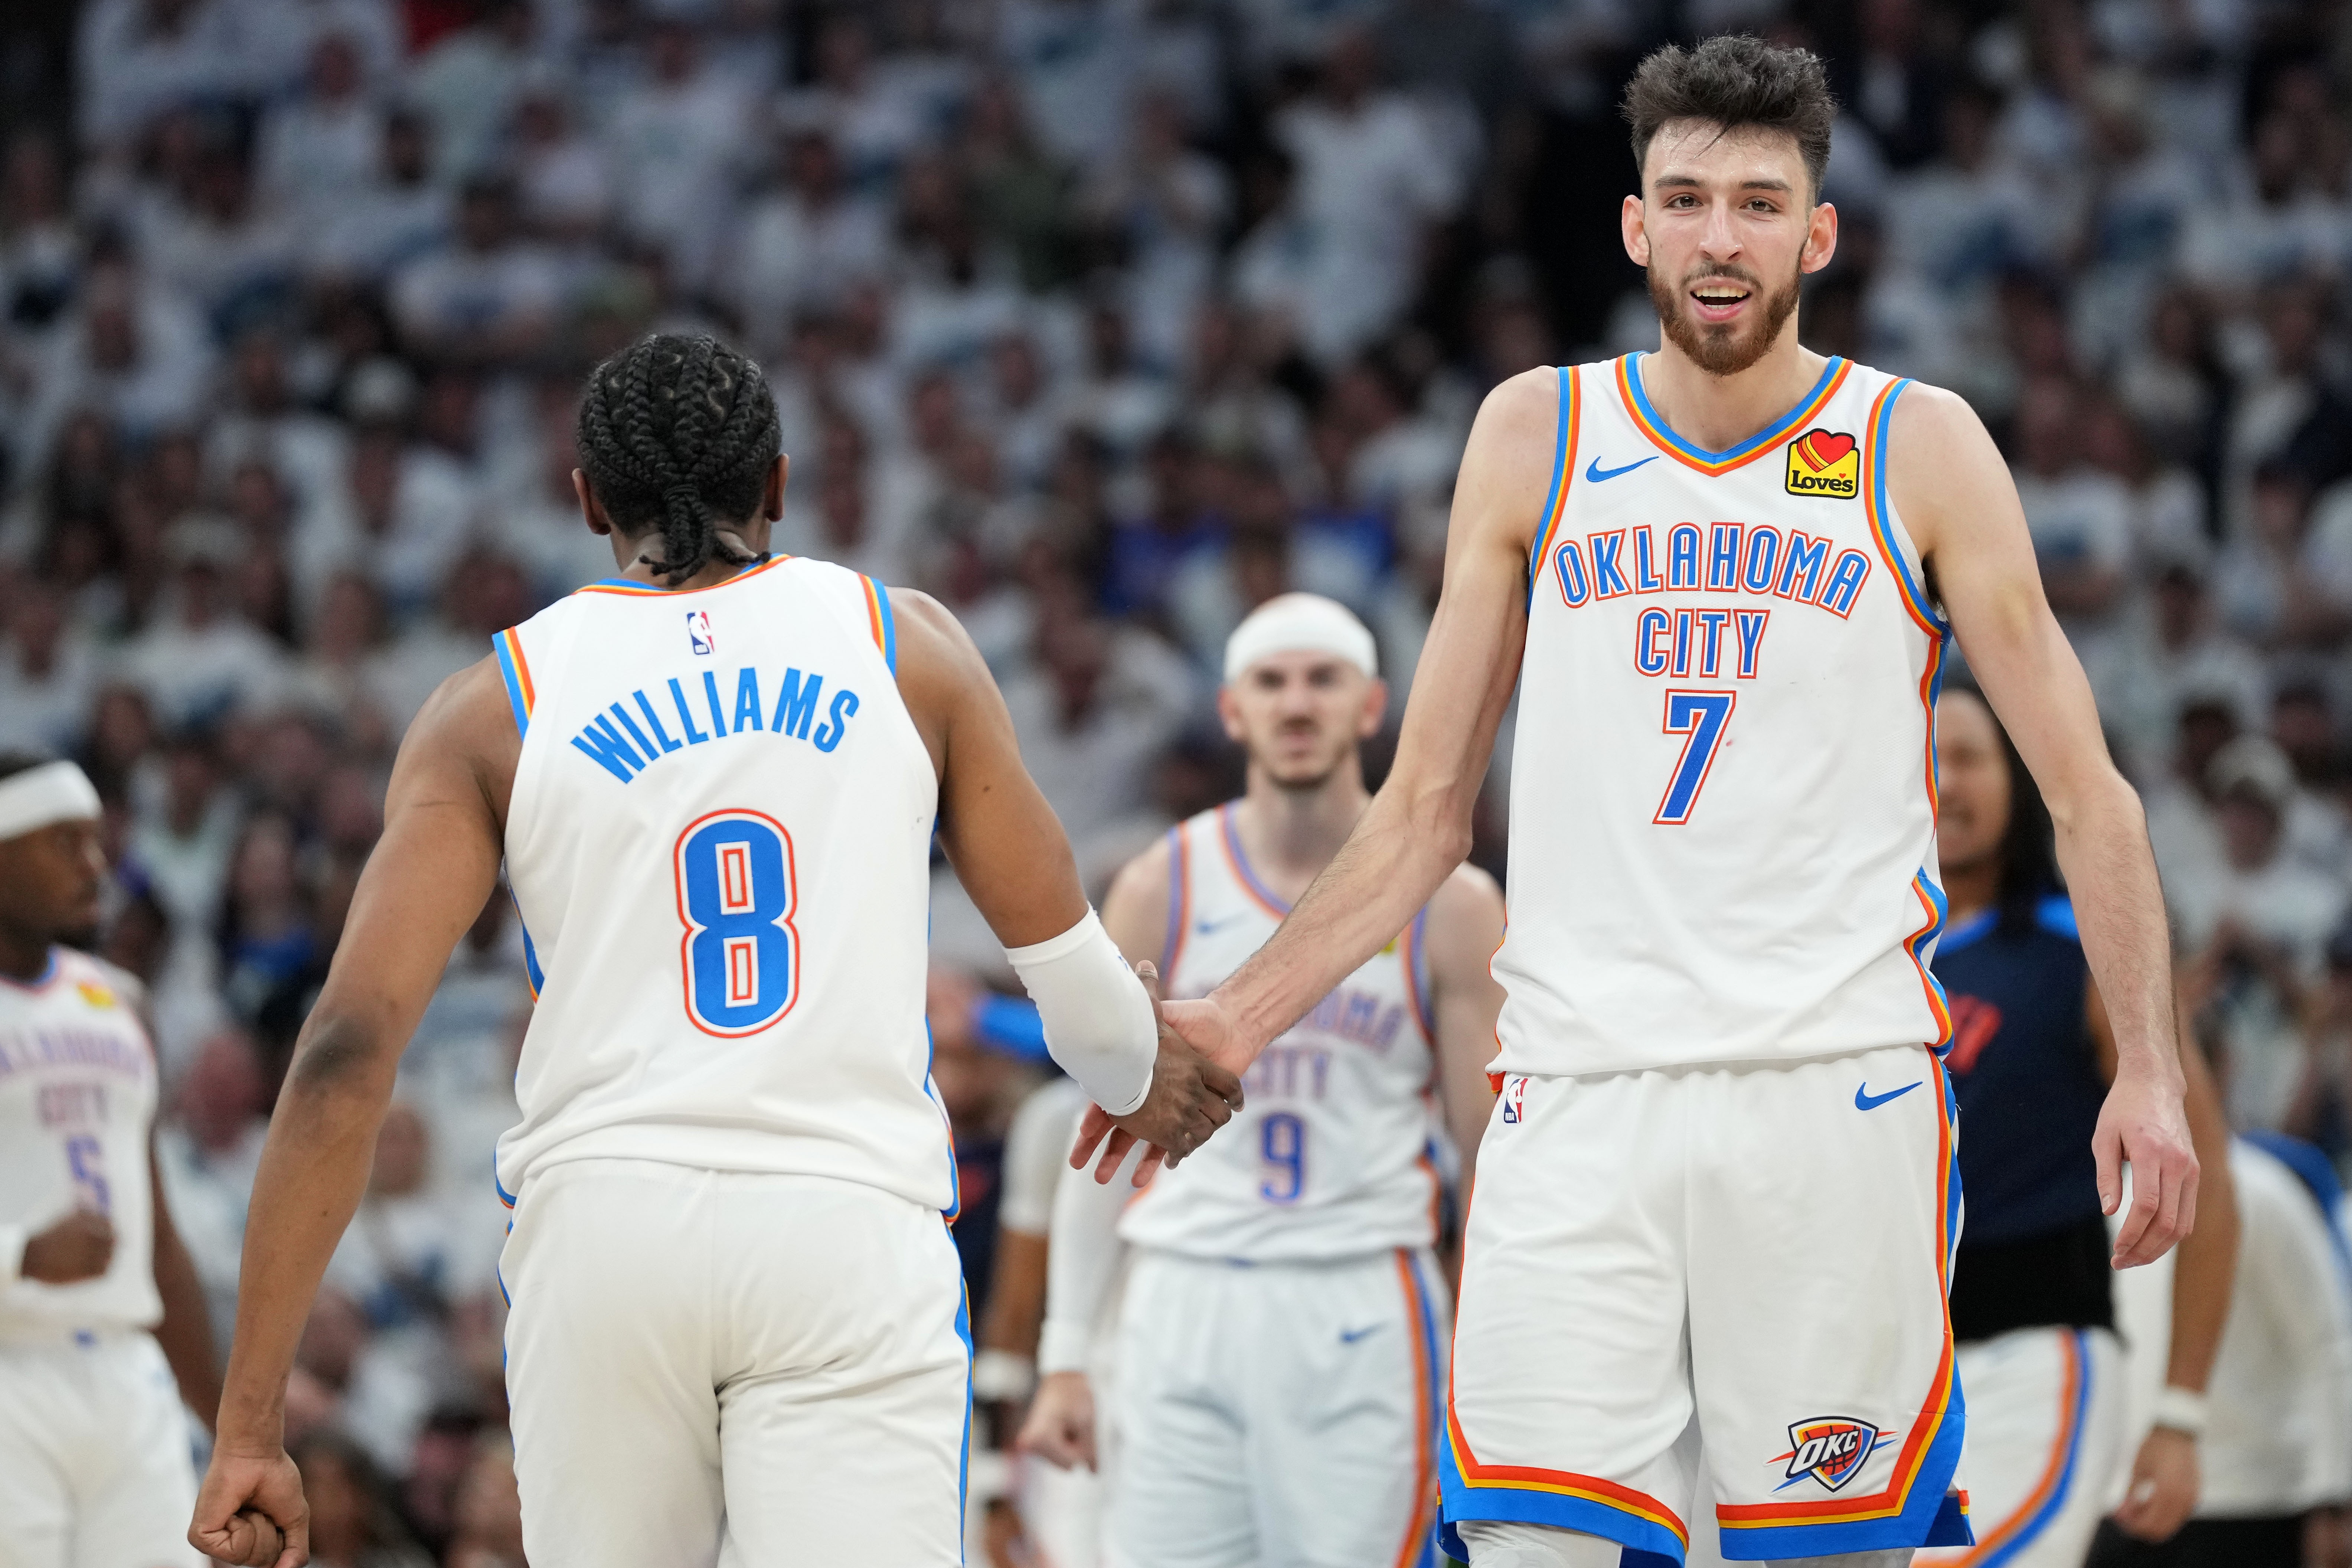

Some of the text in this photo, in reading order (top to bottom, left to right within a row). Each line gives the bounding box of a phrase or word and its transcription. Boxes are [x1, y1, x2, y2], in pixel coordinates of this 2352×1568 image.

[1553, 522, 1872, 620] OKLAHOMA
[1634, 607, 1770, 679] CITY
[571, 667, 859, 784] WILLIAMS
[1652, 689, 1737, 825] 7
[673, 808, 800, 1039] 8
[1260, 1111, 1307, 1206] 9
[1505, 1112, 1515, 1121] NBA
[1786, 1430, 1859, 1477] OKC
